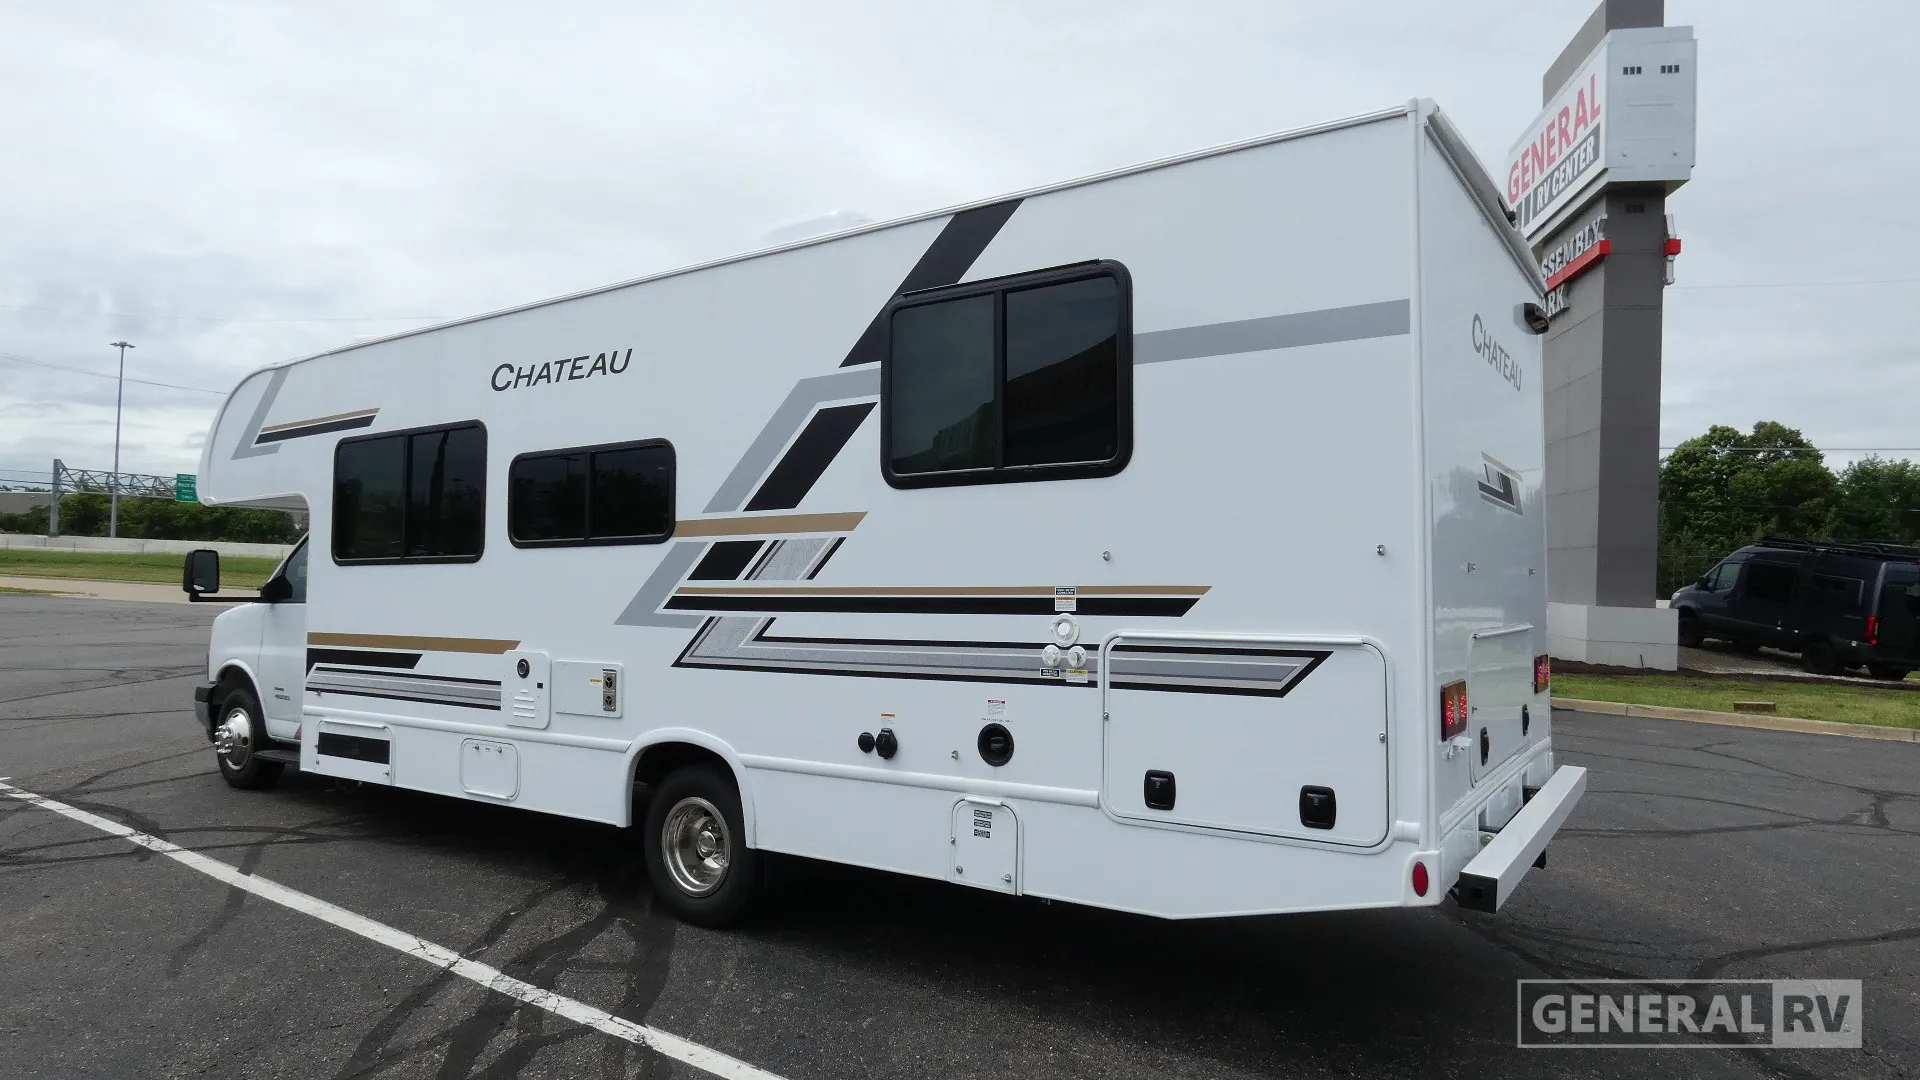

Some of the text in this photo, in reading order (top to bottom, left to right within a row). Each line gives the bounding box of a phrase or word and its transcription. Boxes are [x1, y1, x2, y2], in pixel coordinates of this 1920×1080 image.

[1507, 73, 1601, 204] GENERAL
[1536, 136, 1596, 212] RV CENTER
[1541, 214, 1606, 281] SSEMBLY
[1540, 283, 1567, 317] ARK
[490, 348, 633, 392] CHATEAU
[1472, 313, 1522, 392] CHATEAU
